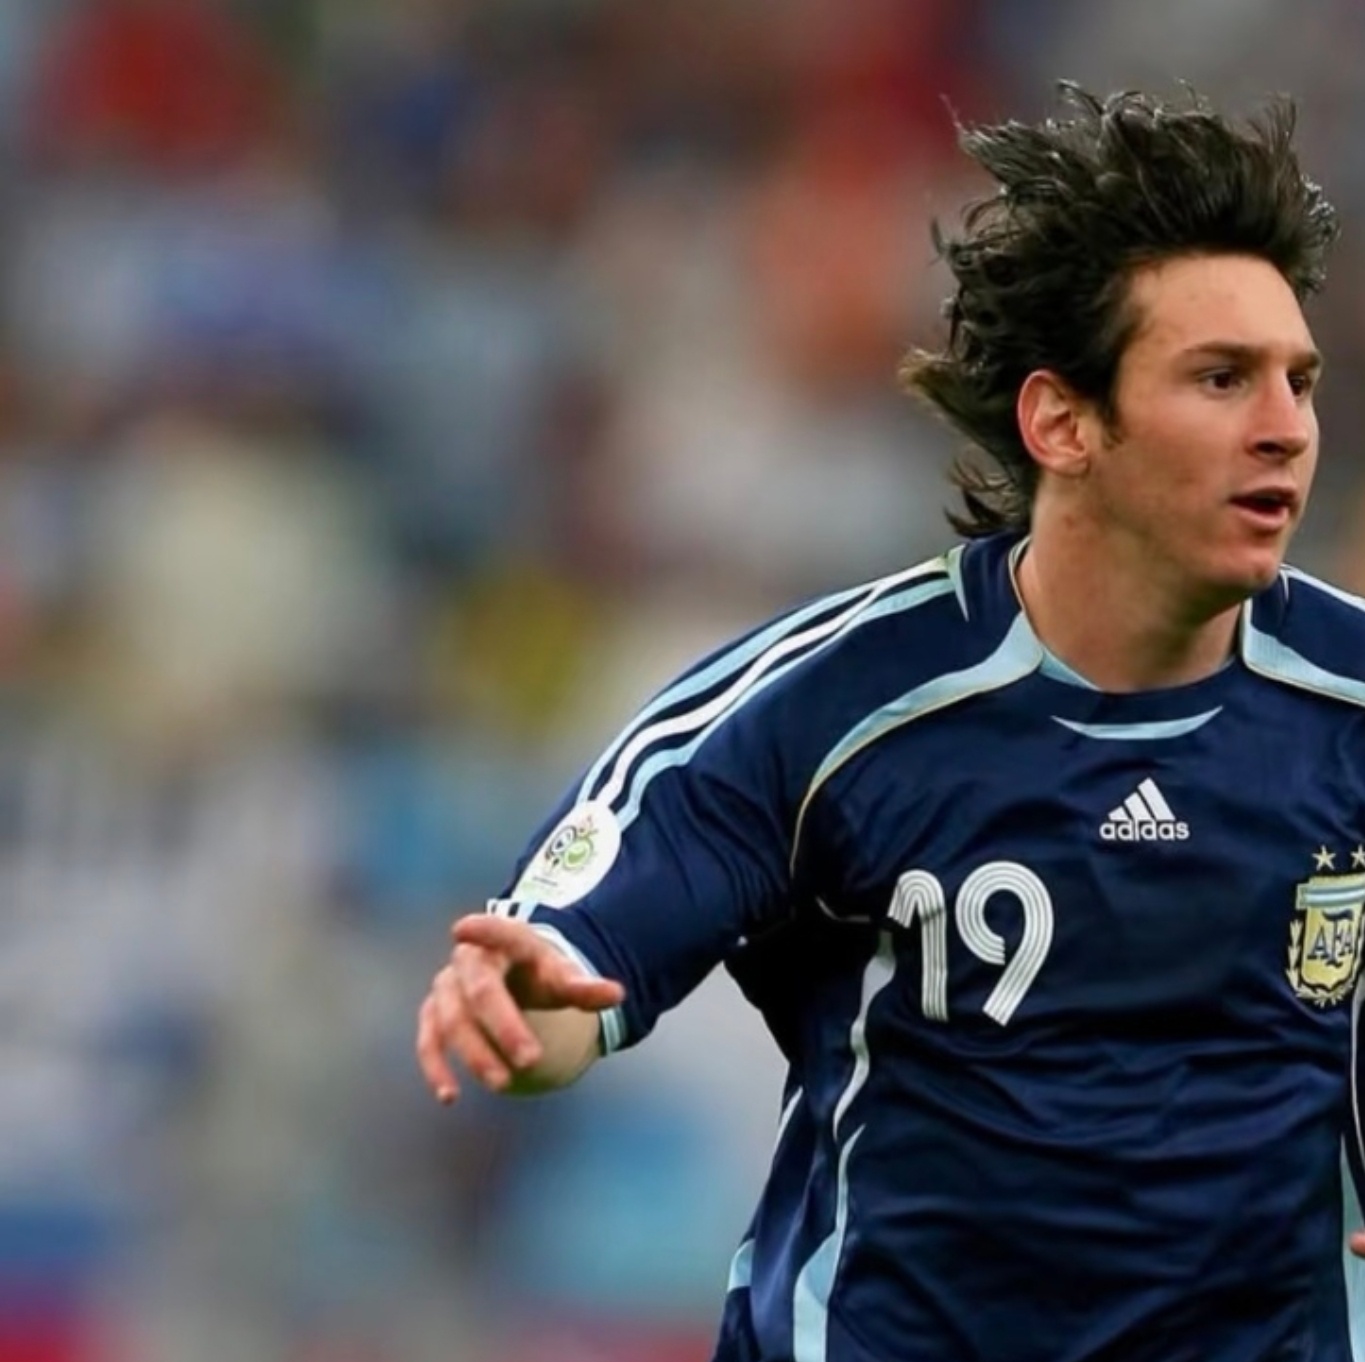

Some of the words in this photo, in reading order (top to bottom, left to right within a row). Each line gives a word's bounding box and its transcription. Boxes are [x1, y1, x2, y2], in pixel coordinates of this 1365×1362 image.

[1099, 819, 1191, 842] adidas
[887, 861, 1054, 1026] 19
[1306, 909, 1354, 968] AFA
